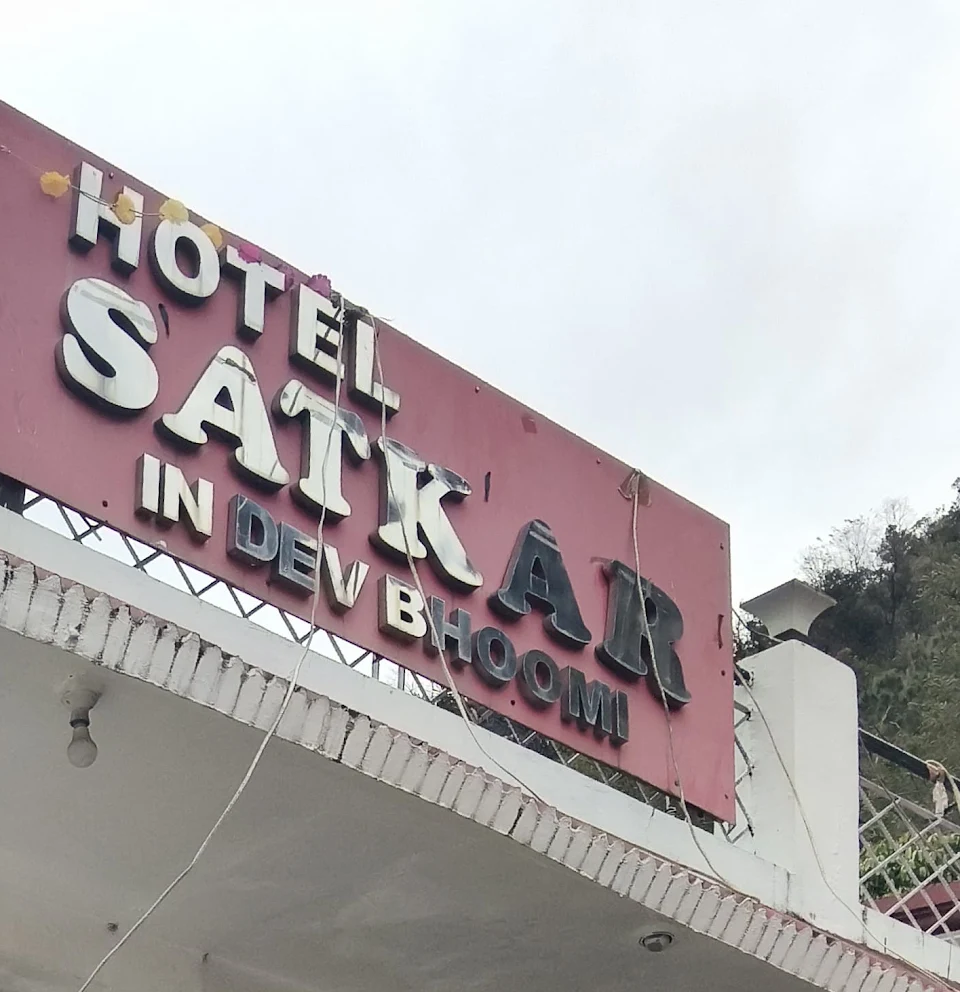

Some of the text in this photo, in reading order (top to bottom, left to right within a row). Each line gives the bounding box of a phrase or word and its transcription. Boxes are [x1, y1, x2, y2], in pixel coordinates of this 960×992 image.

[69, 161, 400, 416] HOTEL
[56, 277, 691, 711] SATKAR
[135, 452, 631, 746] IN DEV BHOOMI
